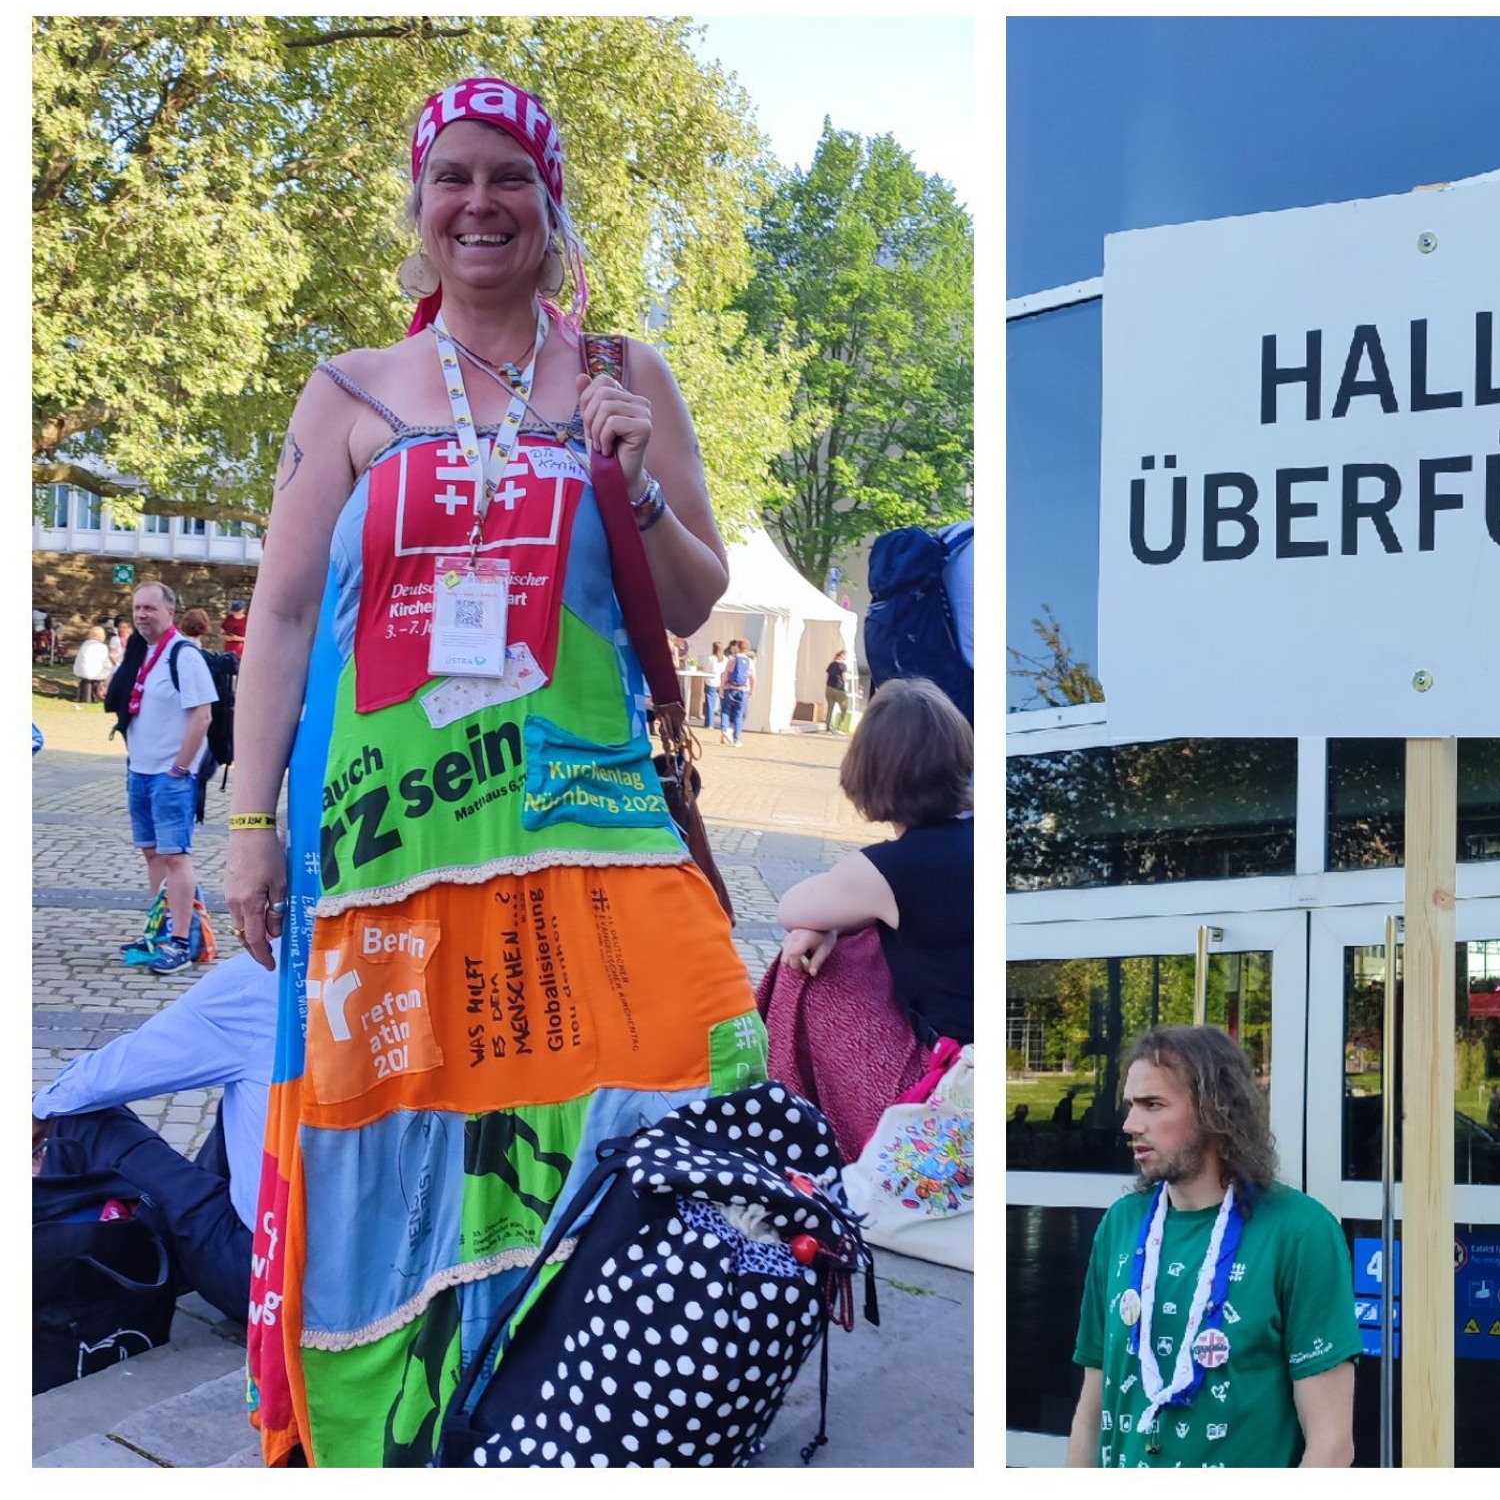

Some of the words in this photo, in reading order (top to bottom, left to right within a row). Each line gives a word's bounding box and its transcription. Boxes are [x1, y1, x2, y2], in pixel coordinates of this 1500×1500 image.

[389, 601, 435, 618] Kirche
[508, 592, 528, 606] art
[391, 584, 435, 599] Deutsc
[509, 572, 549, 587] ischer
[400, 721, 523, 819] sein
[549, 760, 645, 790] Kirchentag
[290, 895, 300, 957] Hamburg
[529, 887, 564, 1052] Globalisierung
[551, 915, 572, 998] denken
[610, 929, 629, 984] DEUTSCHER
[465, 955, 486, 1014] HILFT
[490, 972, 503, 1022] DEM
[468, 1023, 485, 1067] WAS
[491, 1035, 506, 1058] ES
[569, 1005, 581, 1047] neu
[618, 992, 641, 1052] KIRCHENTAG
